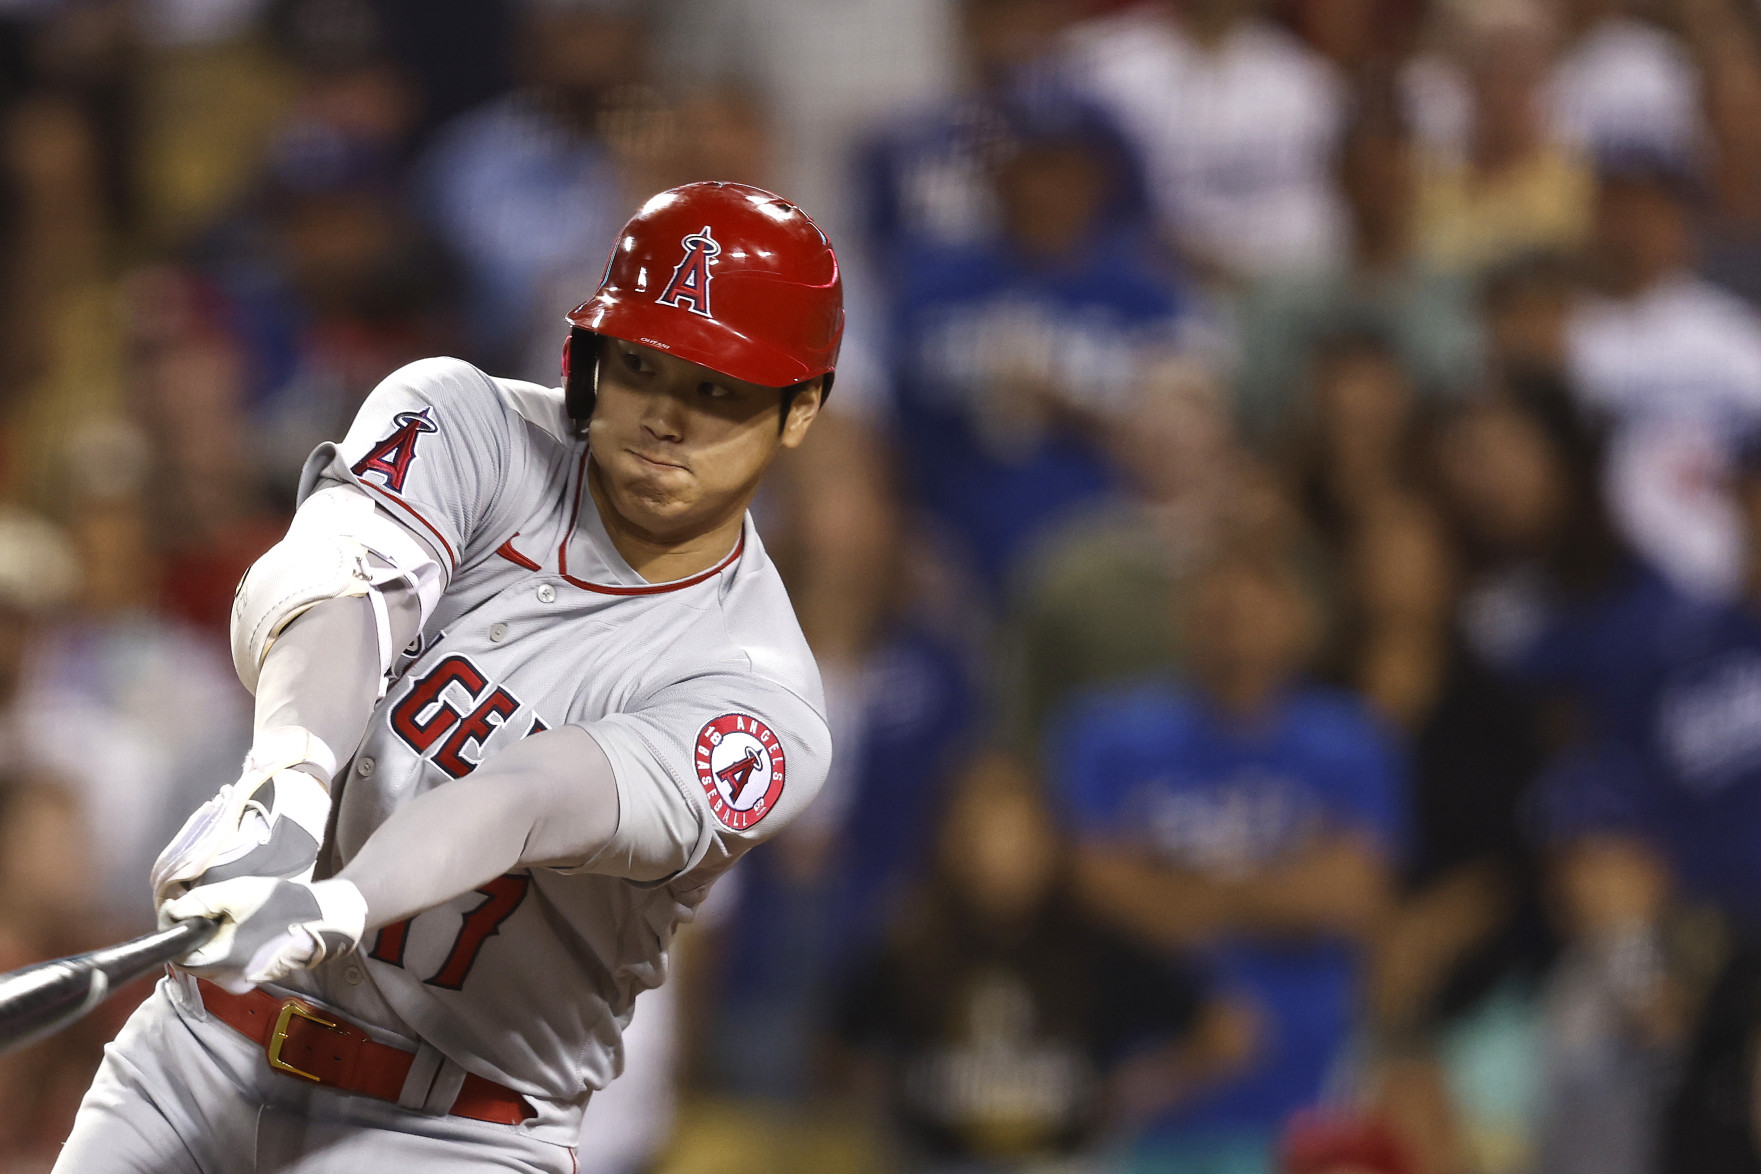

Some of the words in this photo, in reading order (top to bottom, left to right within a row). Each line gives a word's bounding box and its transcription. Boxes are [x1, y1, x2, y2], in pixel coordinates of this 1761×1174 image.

[655, 226, 721, 318] A
[350, 406, 439, 497] A
[697, 745, 747, 826] BASEBALL
[737, 716, 783, 781] ANGELS
